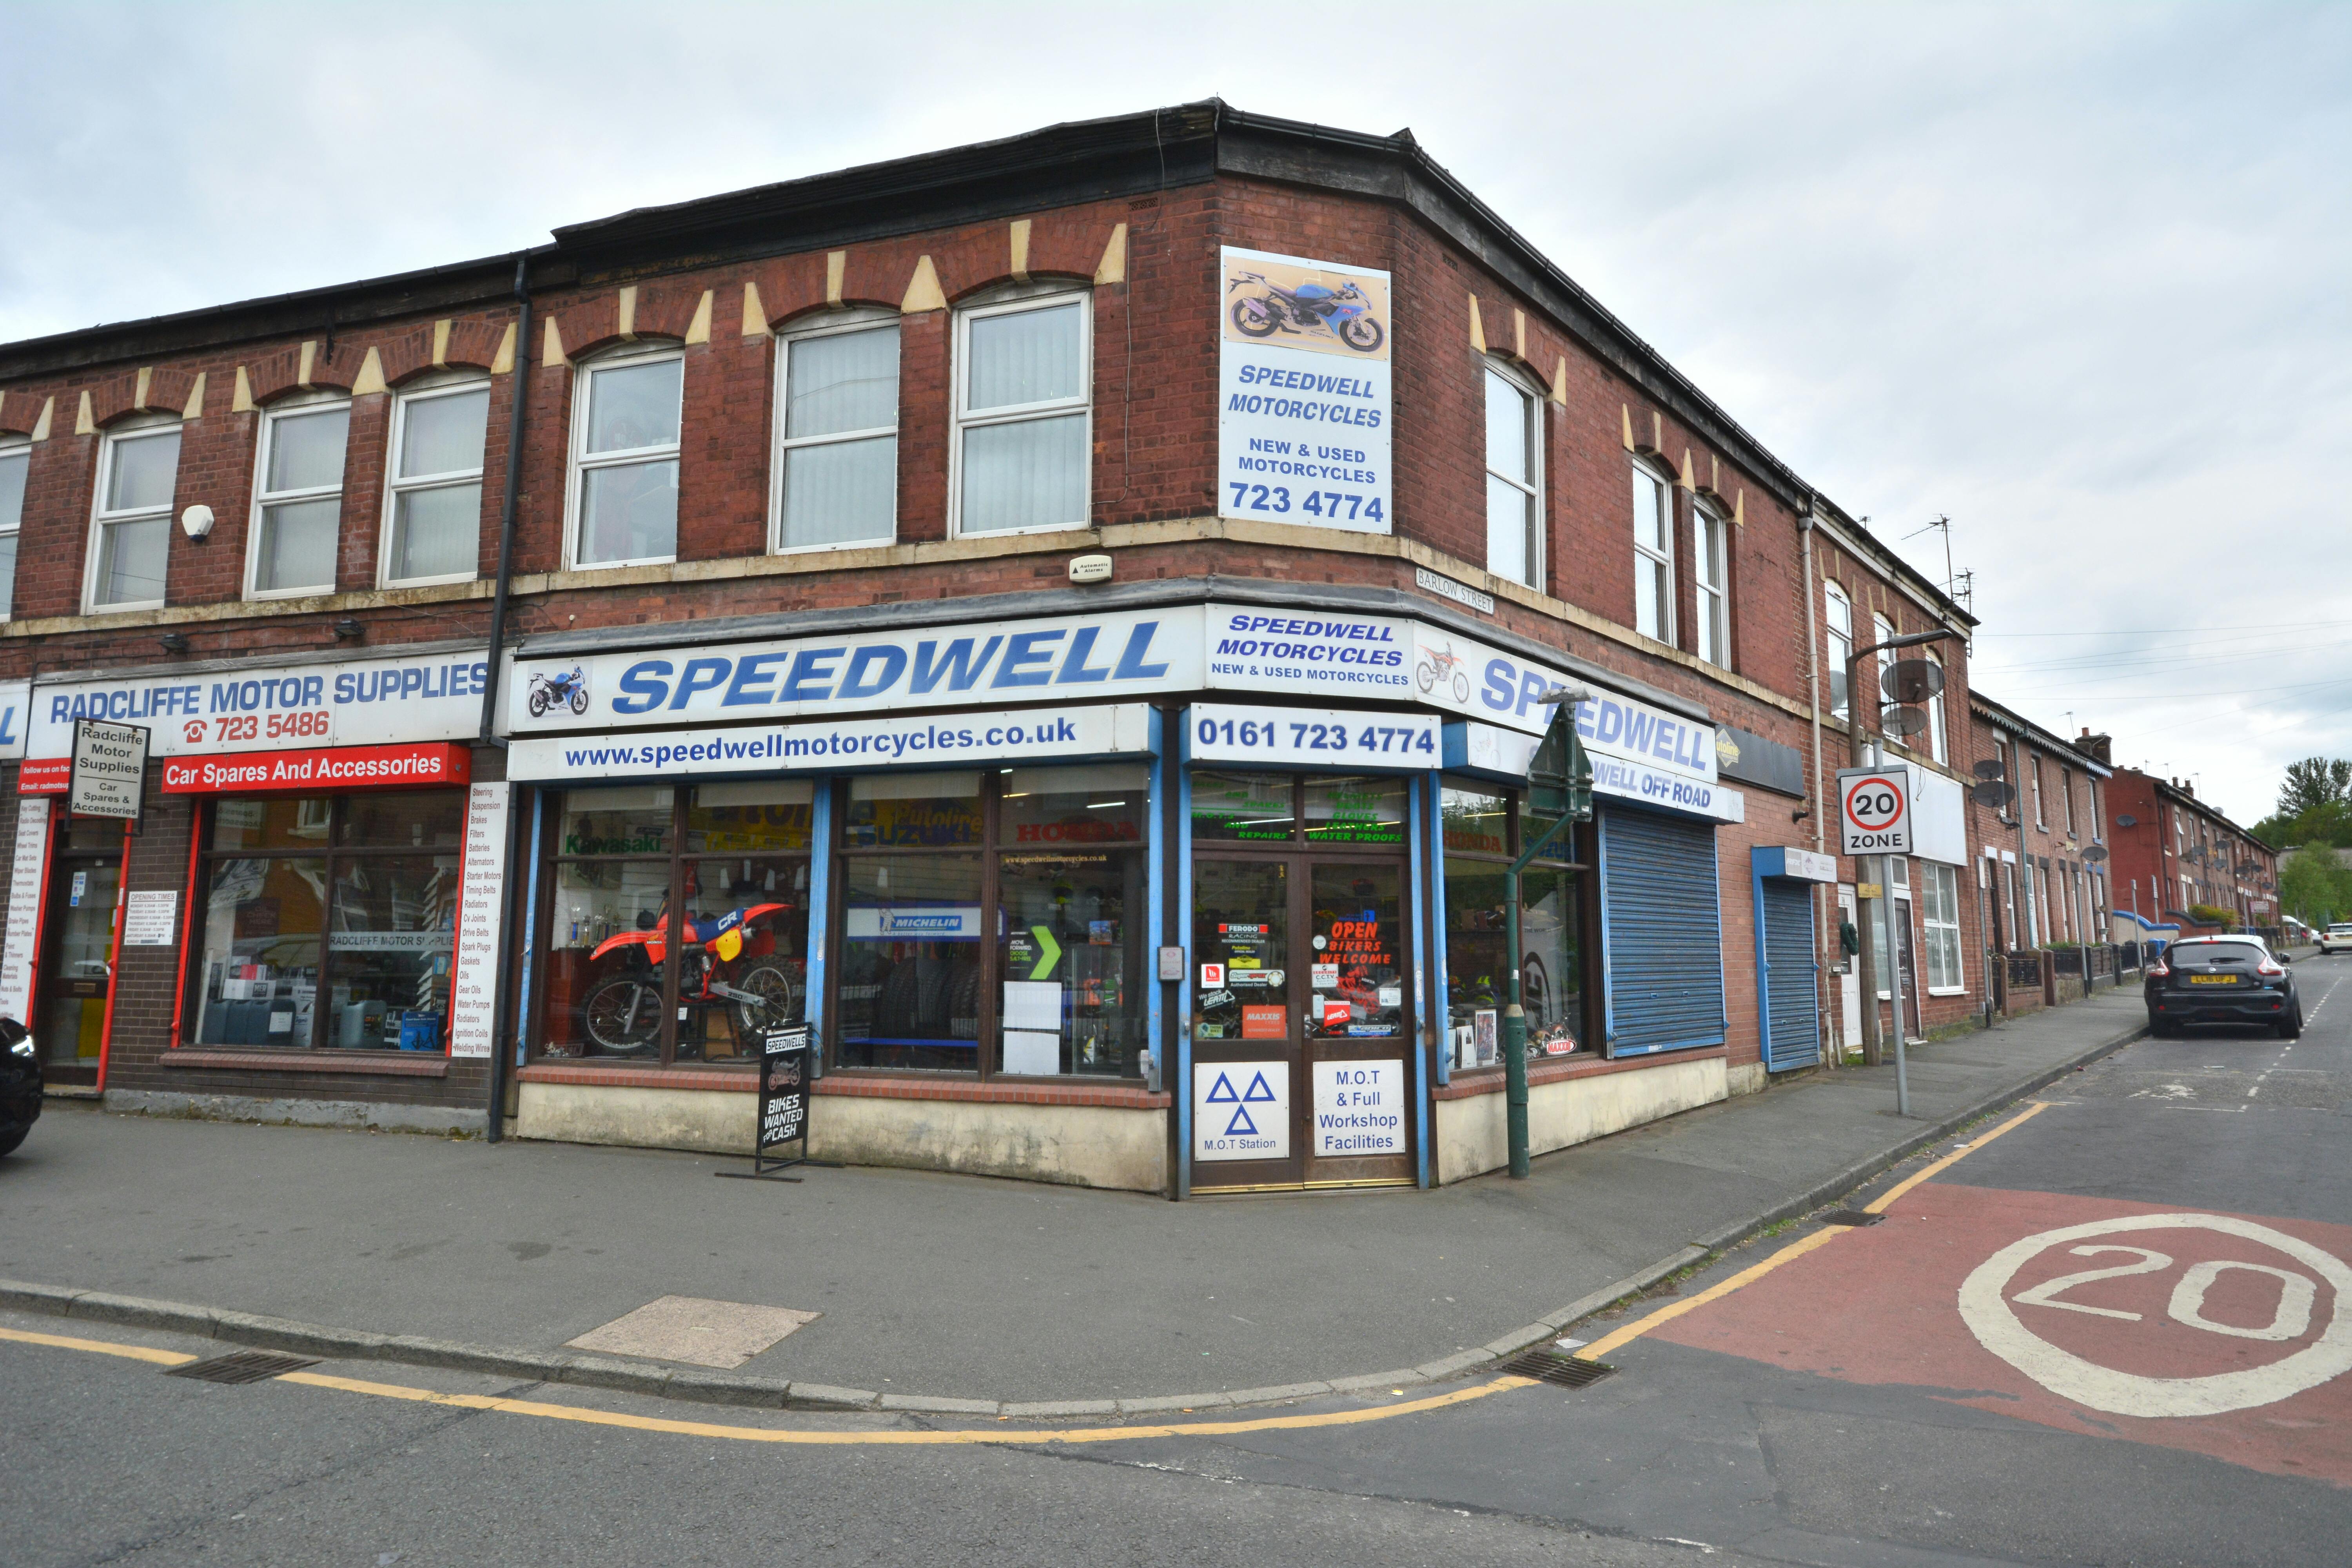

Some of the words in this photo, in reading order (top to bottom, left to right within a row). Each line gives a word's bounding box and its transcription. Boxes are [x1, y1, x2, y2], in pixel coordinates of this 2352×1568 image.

[1239, 365, 1374, 398] SPEEDWELL
[1228, 394, 1381, 428] MOTORCYCLES
[1250, 438, 1291, 454] NEW
[1298, 443, 1310, 456] &
[1318, 446, 1366, 463] USED
[1239, 457, 1376, 484] MOTORCYCLES
[1229, 482, 1291, 512] 723
[1303, 491, 1383, 522] 4774
[1419, 570, 1457, 597] BARLOW
[1461, 588, 1492, 611] STREET
[1229, 615, 1394, 642] SPEEDWELL
[1216, 640, 1403, 667] MOTORCYCLES
[612, 621, 1170, 714] SPEEDWELL
[1212, 663, 1243, 675] NEW
[1249, 665, 1259, 675] &
[1265, 667, 1302, 679] USED
[1307, 670, 1408, 685] MOTORCYCLES
[51, 685, 201, 724] RADCLIFFE
[210, 675, 323, 713] MOTOR
[334, 662, 488, 704] SUPPLIES
[215, 716, 258, 742] 723
[266, 711, 329, 739] 5486
[82, 727, 143, 745] Radcliffe
[565, 717, 1076, 768] www.speedwellmotorcycles.co.uk
[1198, 719, 1275, 747] 0161
[1290, 722, 1348, 750] 723
[1358, 726, 1434, 754] 4774
[91, 744, 132, 758] Motor
[79, 758, 140, 774] Supplies
[166, 764, 198, 785] Car
[203, 763, 267, 788] Spares
[273, 759, 311, 780] And
[317, 753, 441, 778] Accessories
[100, 783, 117, 792] Car
[473, 788, 493, 797] Steering
[1641, 773, 1671, 797] OFF
[1672, 783, 1711, 808] ROAD
[83, 793, 120, 804] Spares
[123, 795, 130, 804] &
[1856, 793, 1895, 815] 20
[74, 802, 136, 815] Accessories
[472, 801, 500, 812] Suspension
[471, 815, 487, 824] Brakes
[1326, 822, 1385, 831] LEATHERS
[1017, 820, 1141, 842] HONDA
[1308, 832, 1352, 841] WATER
[1355, 833, 1402, 842] PROOFS
[565, 833, 661, 854] Kawasaki
[1851, 833, 1902, 848] ZONE
[469, 844, 490, 852] Batteries
[467, 857, 494, 866] Alternators
[1005, 854, 1107, 864] www.speedwellmotorcycles.co.uk
[466, 871, 483, 880] Starter
[484, 871, 501, 880] Motors
[466, 886, 482, 896] Timing
[483, 886, 496, 894] Belts
[465, 900, 488, 908] Radiators
[464, 914, 470, 922] Cv
[471, 914, 486, 922] Joints
[718, 910, 738, 931] CR
[895, 918, 959, 927] MICHELIN
[463, 929, 475, 937] Drive
[1332, 922, 1378, 938] OPEN
[330, 936, 378, 945] RADCLIFFE
[381, 936, 414, 945] MOTOR
[462, 942, 475, 953] Spark
[477, 942, 491, 953] Plugs
[1329, 941, 1382, 951] BIKERS
[461, 957, 480, 965] Gaskets
[1319, 954, 1391, 964] WELCOME
[460, 971, 469, 979] Oils
[459, 985, 470, 994] Gear
[471, 985, 481, 994] Oils
[1207, 989, 1221, 998] stock
[457, 1000, 472, 1009] Water
[472, 1000, 490, 1010] Pumps
[456, 1014, 479, 1023] Radiators
[455, 1029, 474, 1039] Ignition
[475, 1029, 488, 1038] Coils
[454, 1043, 474, 1054] Welding
[767, 1036, 805, 1052] SPEEDWELLS
[1336, 1071, 1380, 1085] M.O.T
[768, 1094, 800, 1114] BIKES
[1337, 1093, 1347, 1106] &
[1353, 1092, 1381, 1105] Full
[765, 1108, 803, 1129] WANTED
[1319, 1114, 1398, 1129] Workshop
[763, 1130, 773, 1143] FOR
[772, 1123, 797, 1141] CASH
[1205, 1140, 1236, 1150] M.O.T
[1239, 1139, 1276, 1149] Station
[1325, 1135, 1393, 1150] Facilities
[2012, 1246, 2317, 1341] 20
